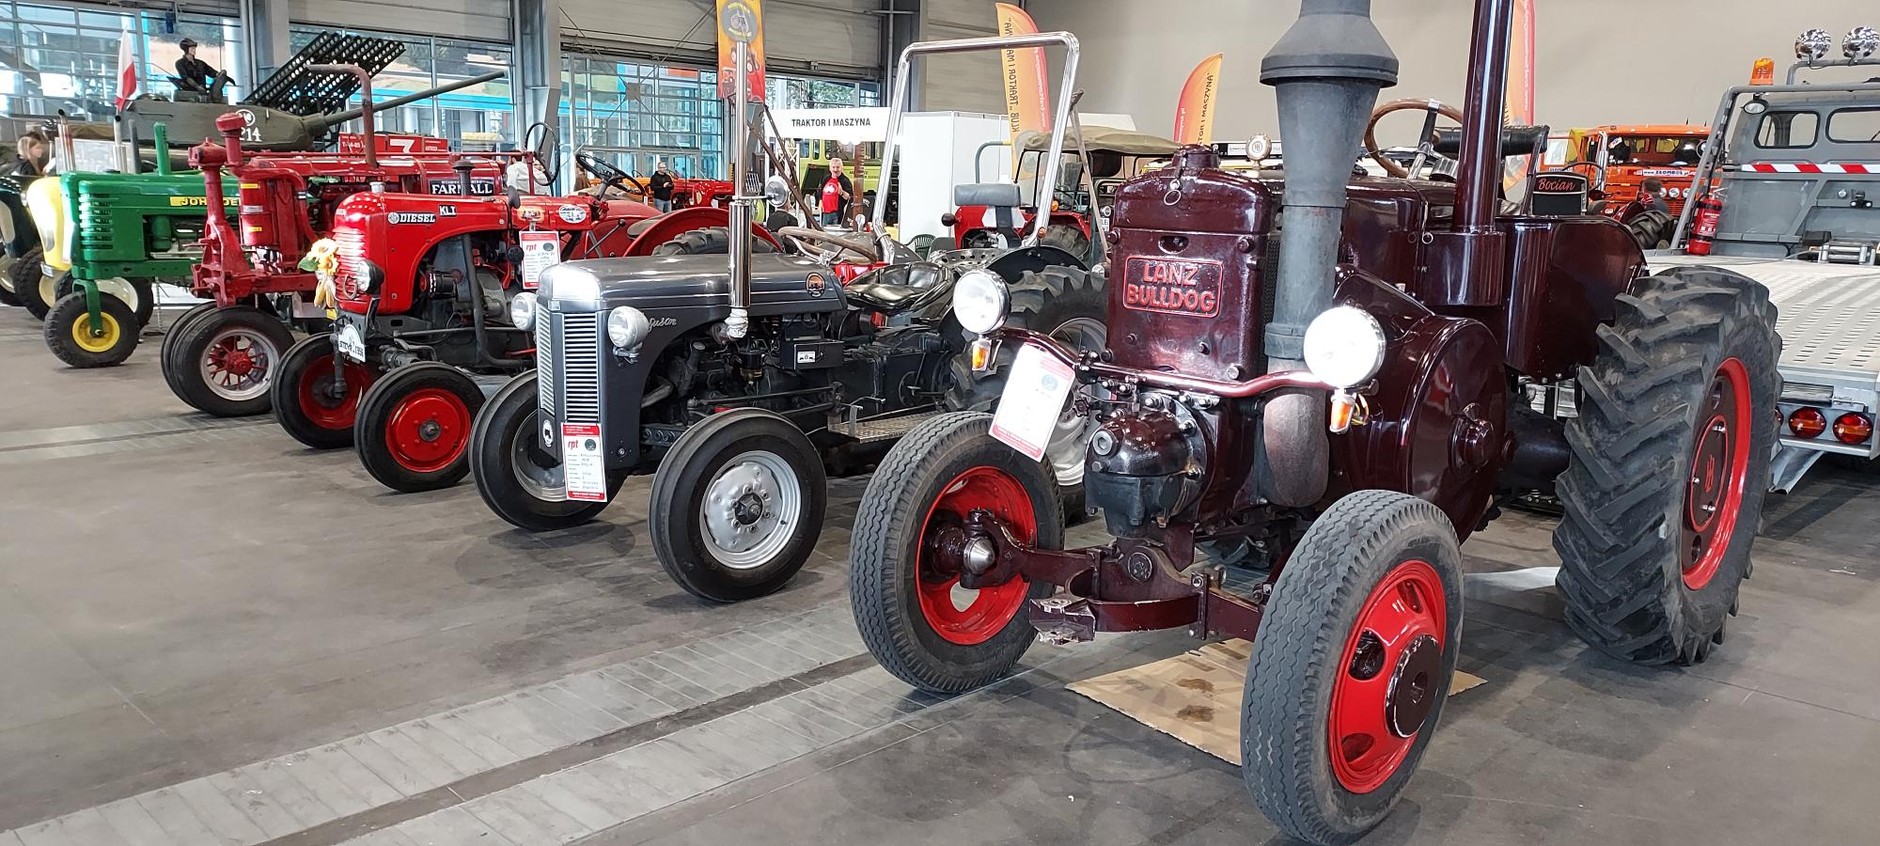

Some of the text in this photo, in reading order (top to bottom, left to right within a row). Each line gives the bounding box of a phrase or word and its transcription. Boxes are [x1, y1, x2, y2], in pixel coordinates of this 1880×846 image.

[791, 118, 826, 127] TRAKTOR
[833, 117, 871, 127] MASZYNA
[1538, 178, 1576, 191] Bocian
[399, 213, 436, 223] DIESEL
[1143, 263, 1199, 286] LANZ
[1126, 283, 1216, 312] BULLDOG
[568, 440, 579, 450] rpt
